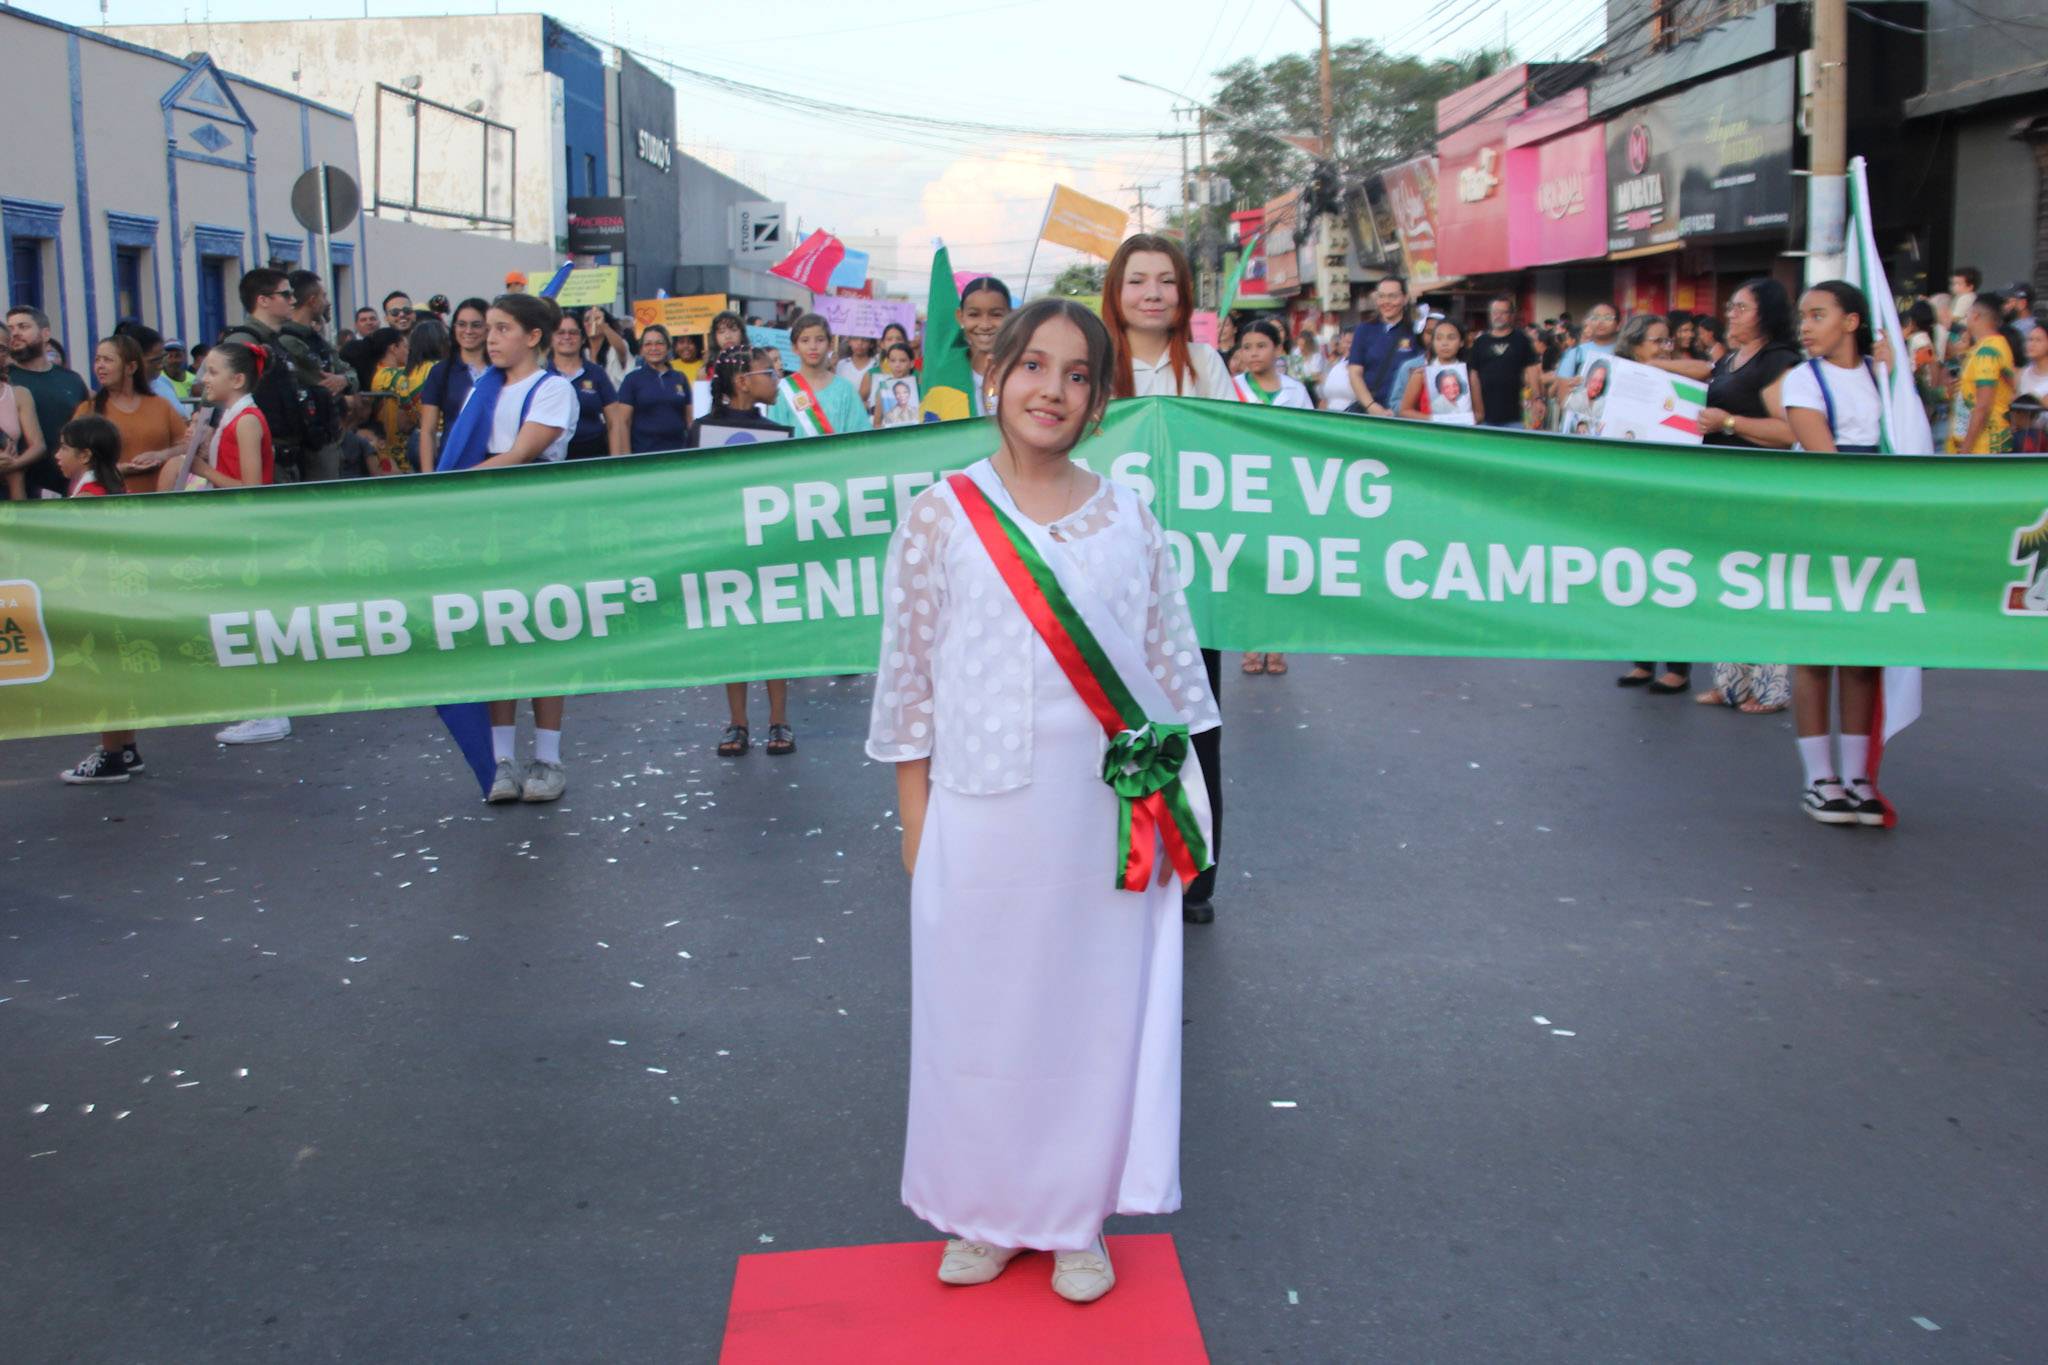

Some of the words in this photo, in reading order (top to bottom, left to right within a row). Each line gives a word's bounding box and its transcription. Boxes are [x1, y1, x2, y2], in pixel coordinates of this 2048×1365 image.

[741, 211, 750, 253] STUDIO
[1178, 451, 1272, 513] DE
[1291, 457, 1393, 519] VG
[209, 599, 412, 668] EMEB
[1266, 535, 1361, 597] DE
[1384, 539, 1698, 608] CAMPOS
[1718, 551, 1926, 614] SILVA
